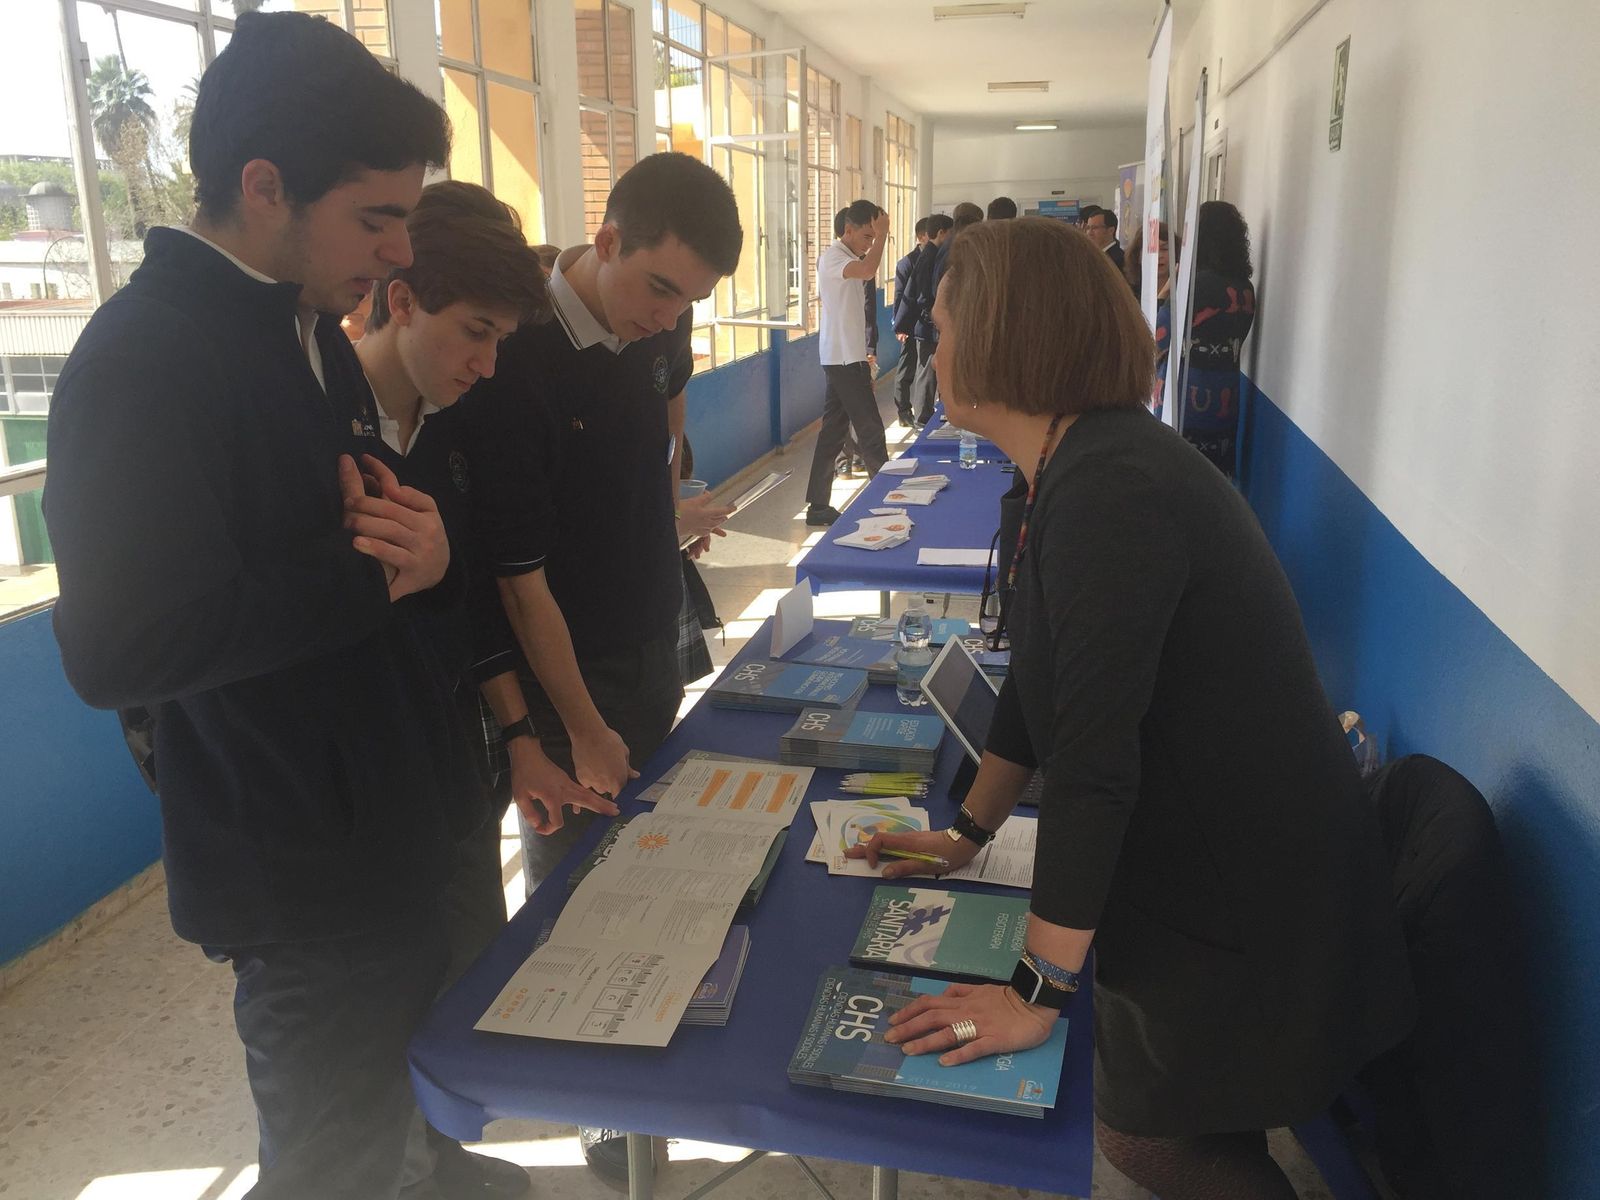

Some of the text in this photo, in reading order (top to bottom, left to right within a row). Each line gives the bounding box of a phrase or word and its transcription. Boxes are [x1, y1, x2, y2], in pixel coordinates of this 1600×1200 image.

[734, 663, 766, 681] CHS
[801, 712, 832, 732] CHS
[861, 899, 913, 958] SANITARIA
[834, 995, 884, 1042] CHS
